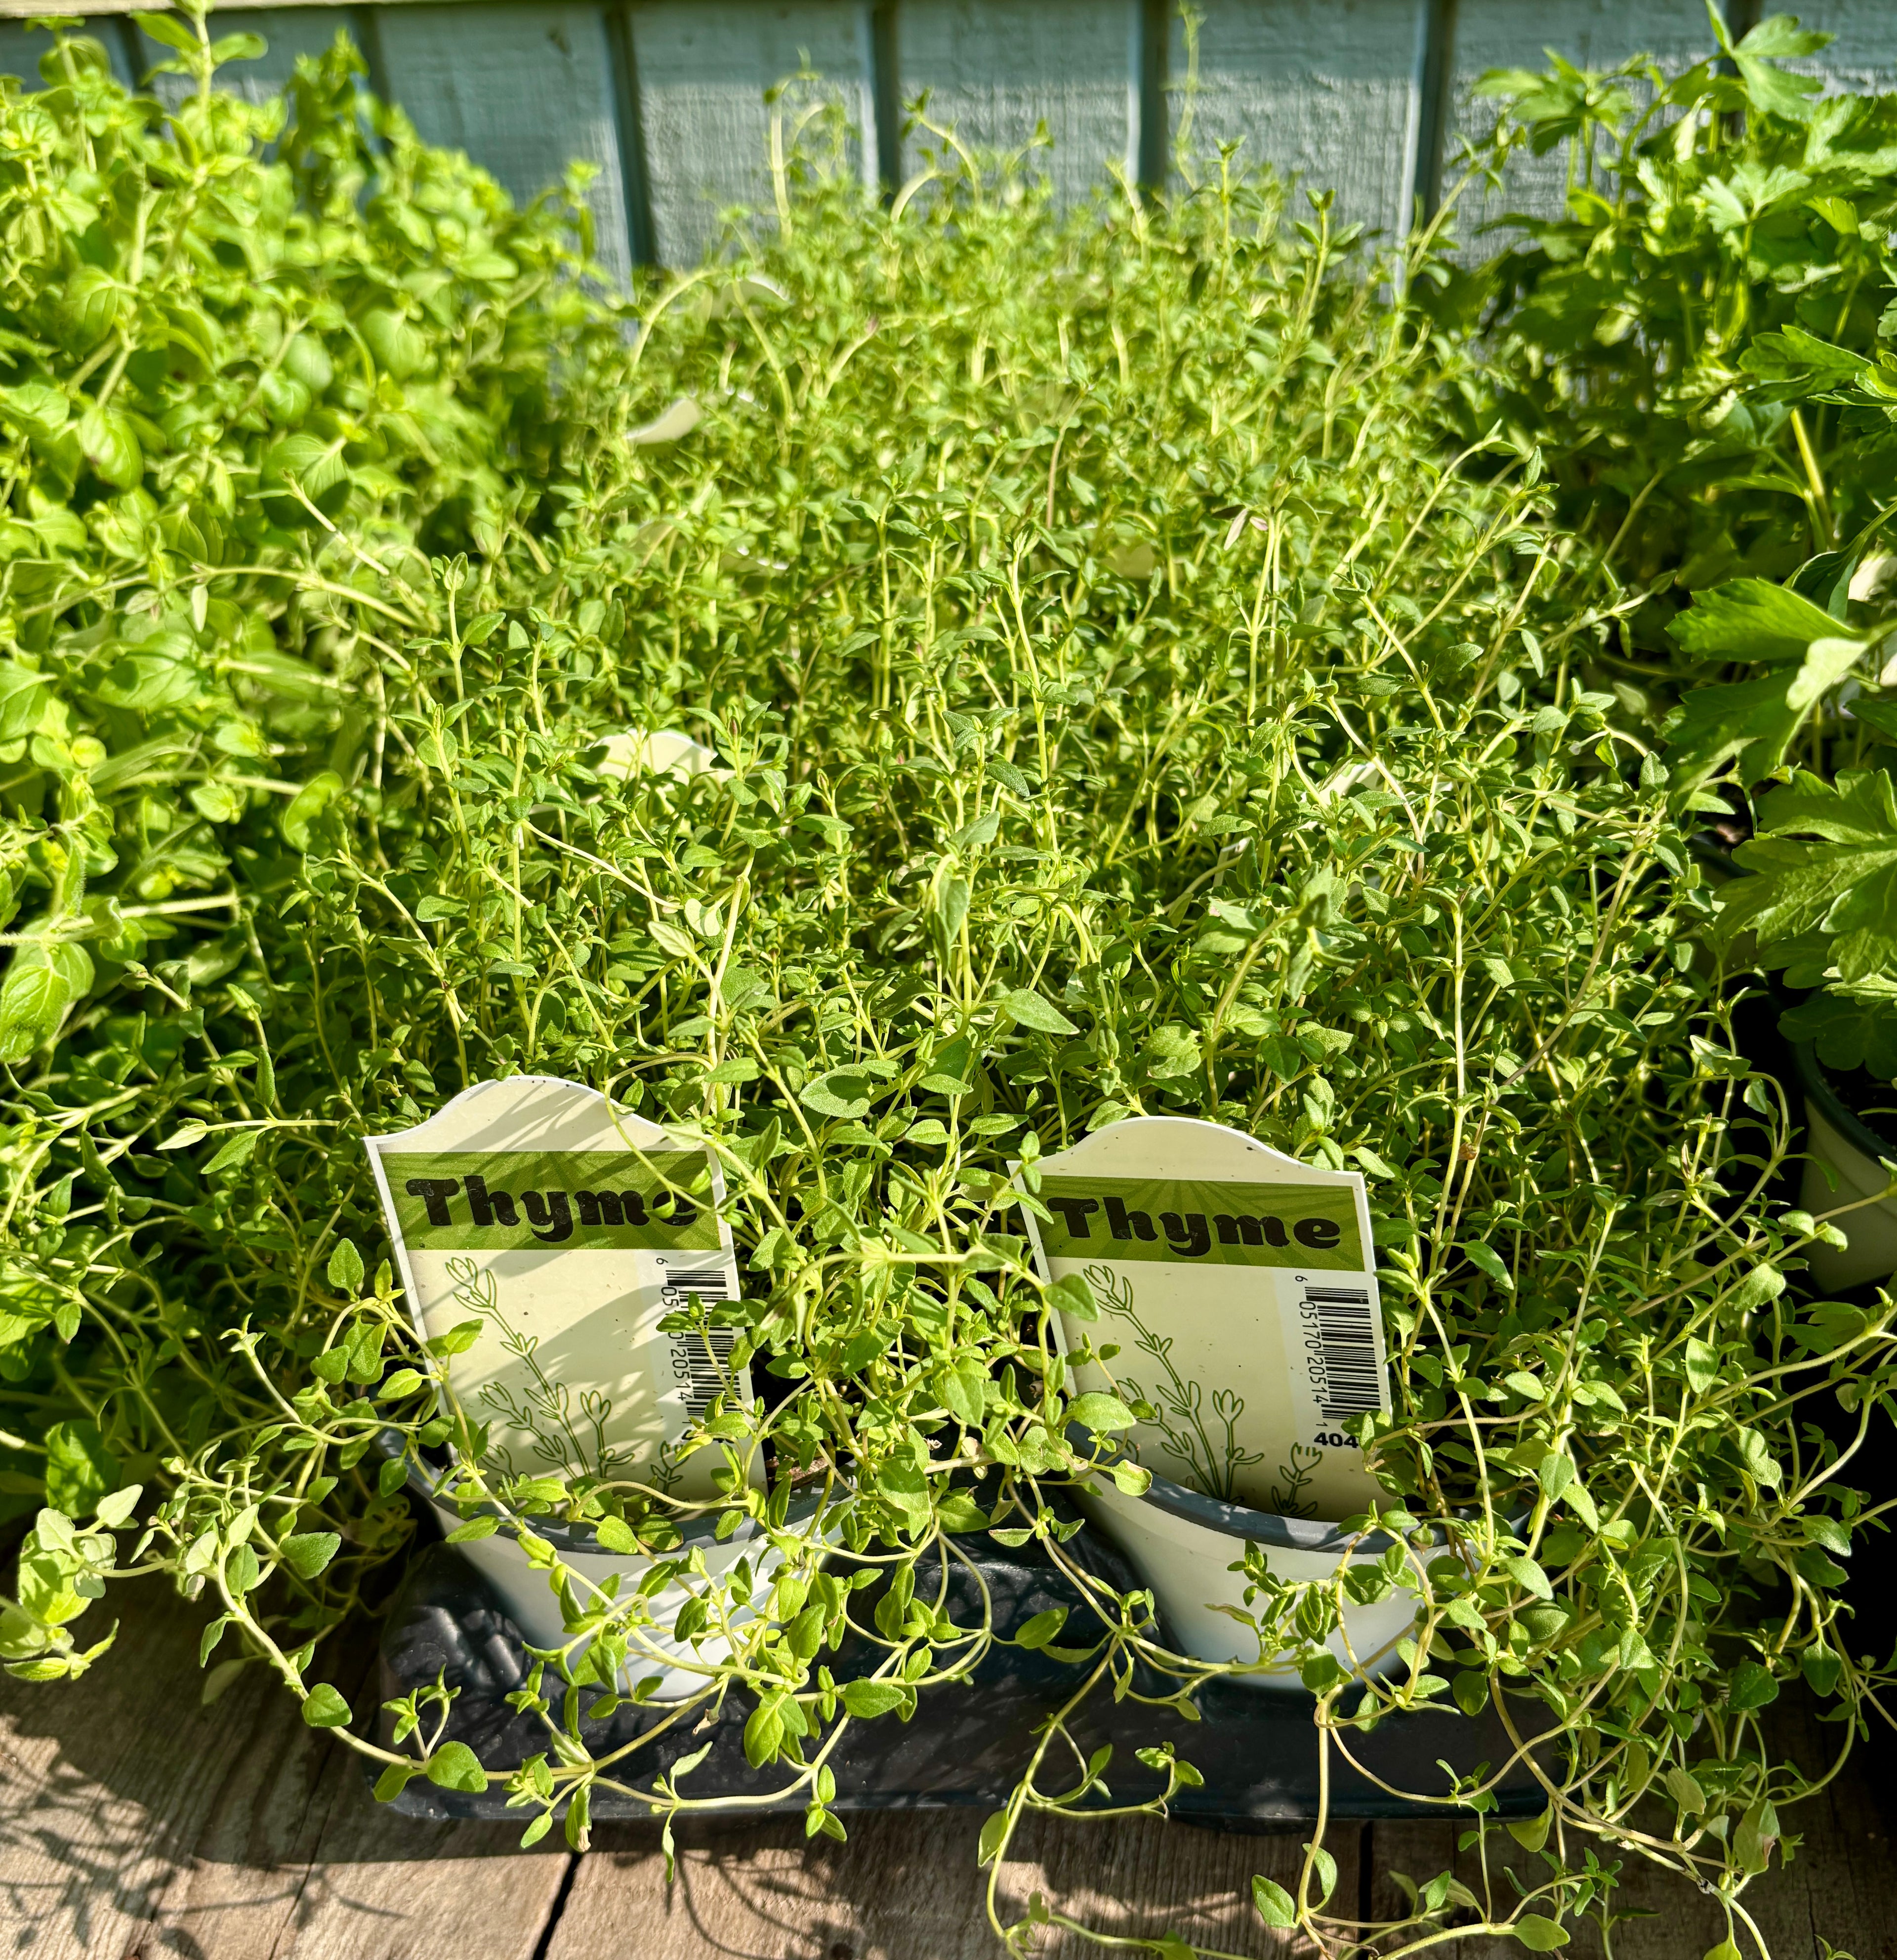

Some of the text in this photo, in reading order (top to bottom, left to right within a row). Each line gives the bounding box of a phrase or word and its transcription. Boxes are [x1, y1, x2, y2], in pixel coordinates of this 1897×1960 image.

[406, 1176, 697, 1242] Thyme
[1046, 1197, 1340, 1256] Thyme
[661, 1286, 684, 1339] 050
[1299, 1301, 1322, 1349] 05170
[671, 1349, 693, 1401] 20514
[1307, 1357, 1329, 1404] 20514
